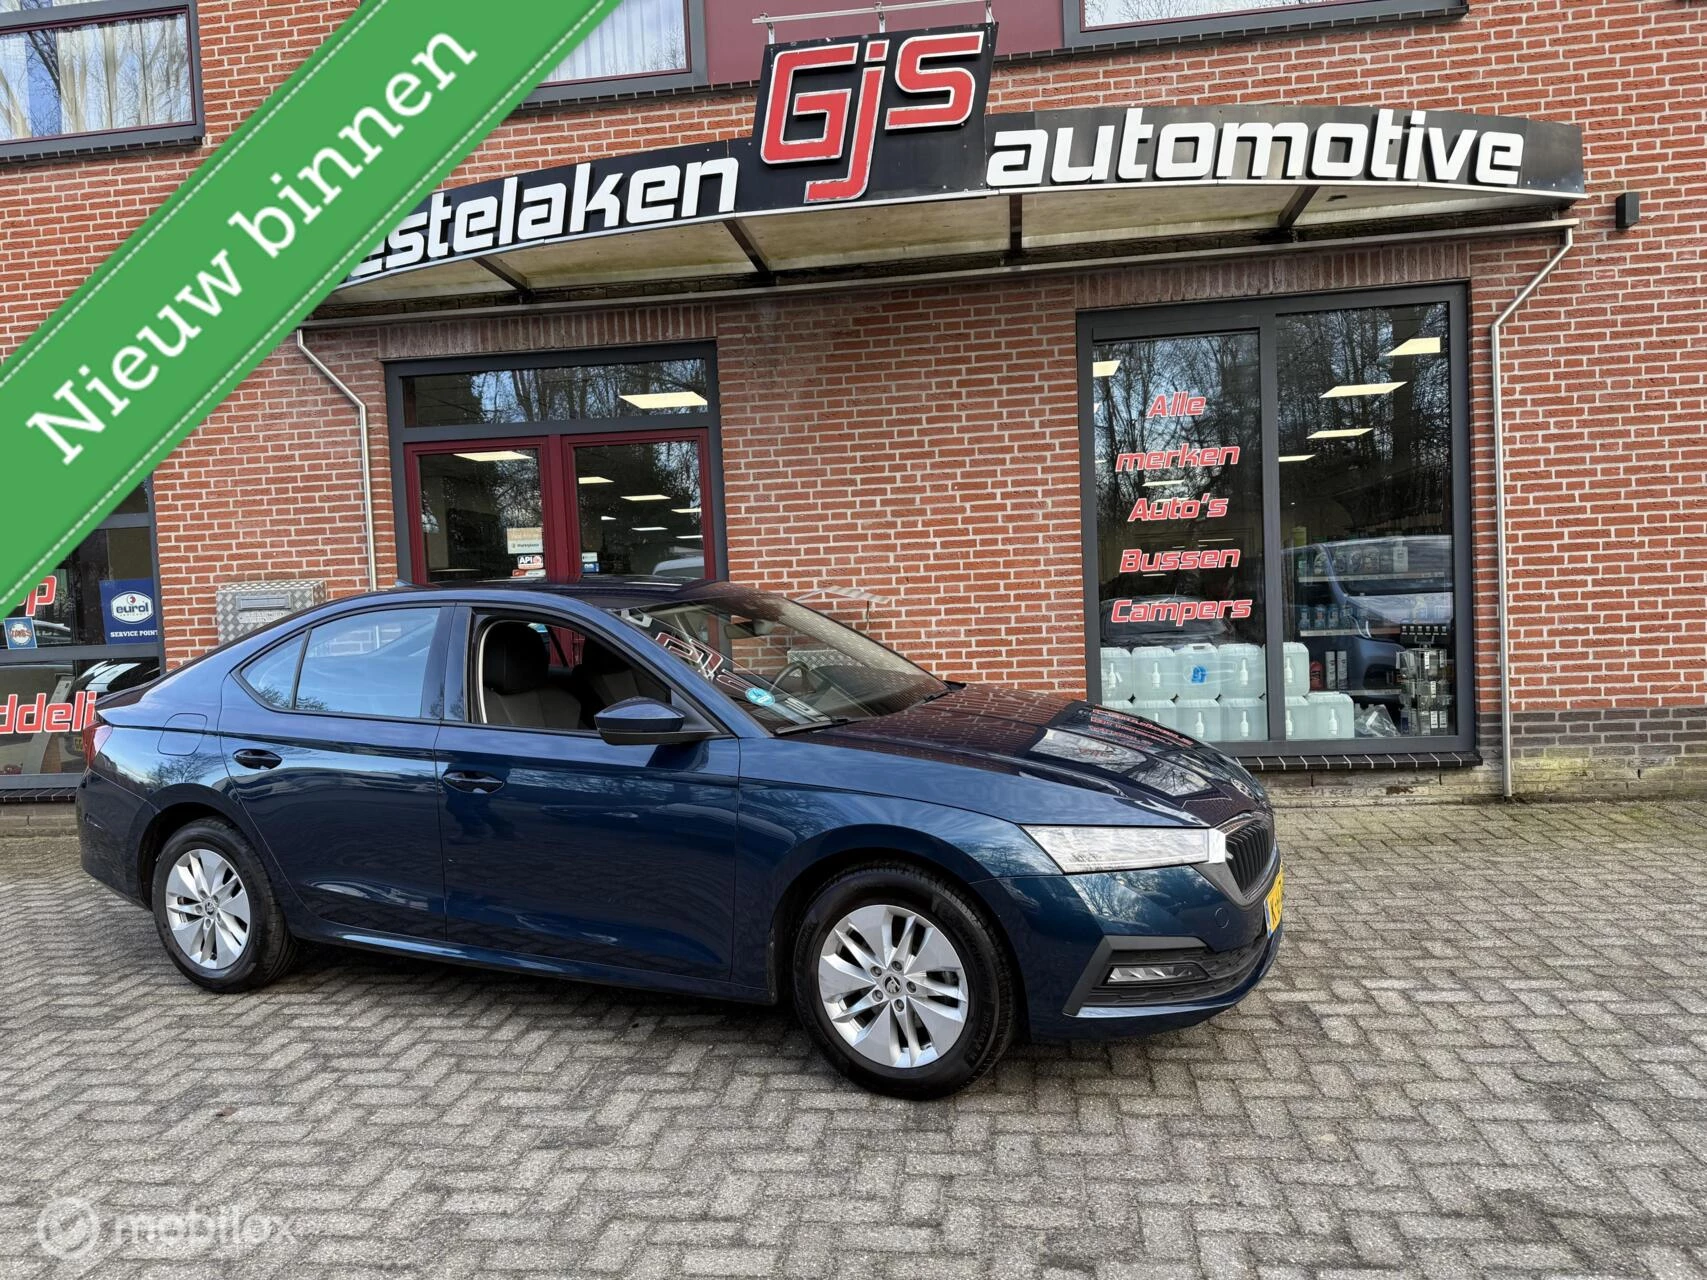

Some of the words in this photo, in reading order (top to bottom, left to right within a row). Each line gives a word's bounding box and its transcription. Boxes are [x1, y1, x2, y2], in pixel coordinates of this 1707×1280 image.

[986, 107, 1524, 187] automotive
[1147, 390, 1207, 419] Alle
[1114, 443, 1241, 473] merken
[1127, 493, 1229, 523] Auto's
[1119, 548, 1241, 574] Bussen
[115, 602, 149, 613] eurol
[1110, 598, 1253, 627] Campers
